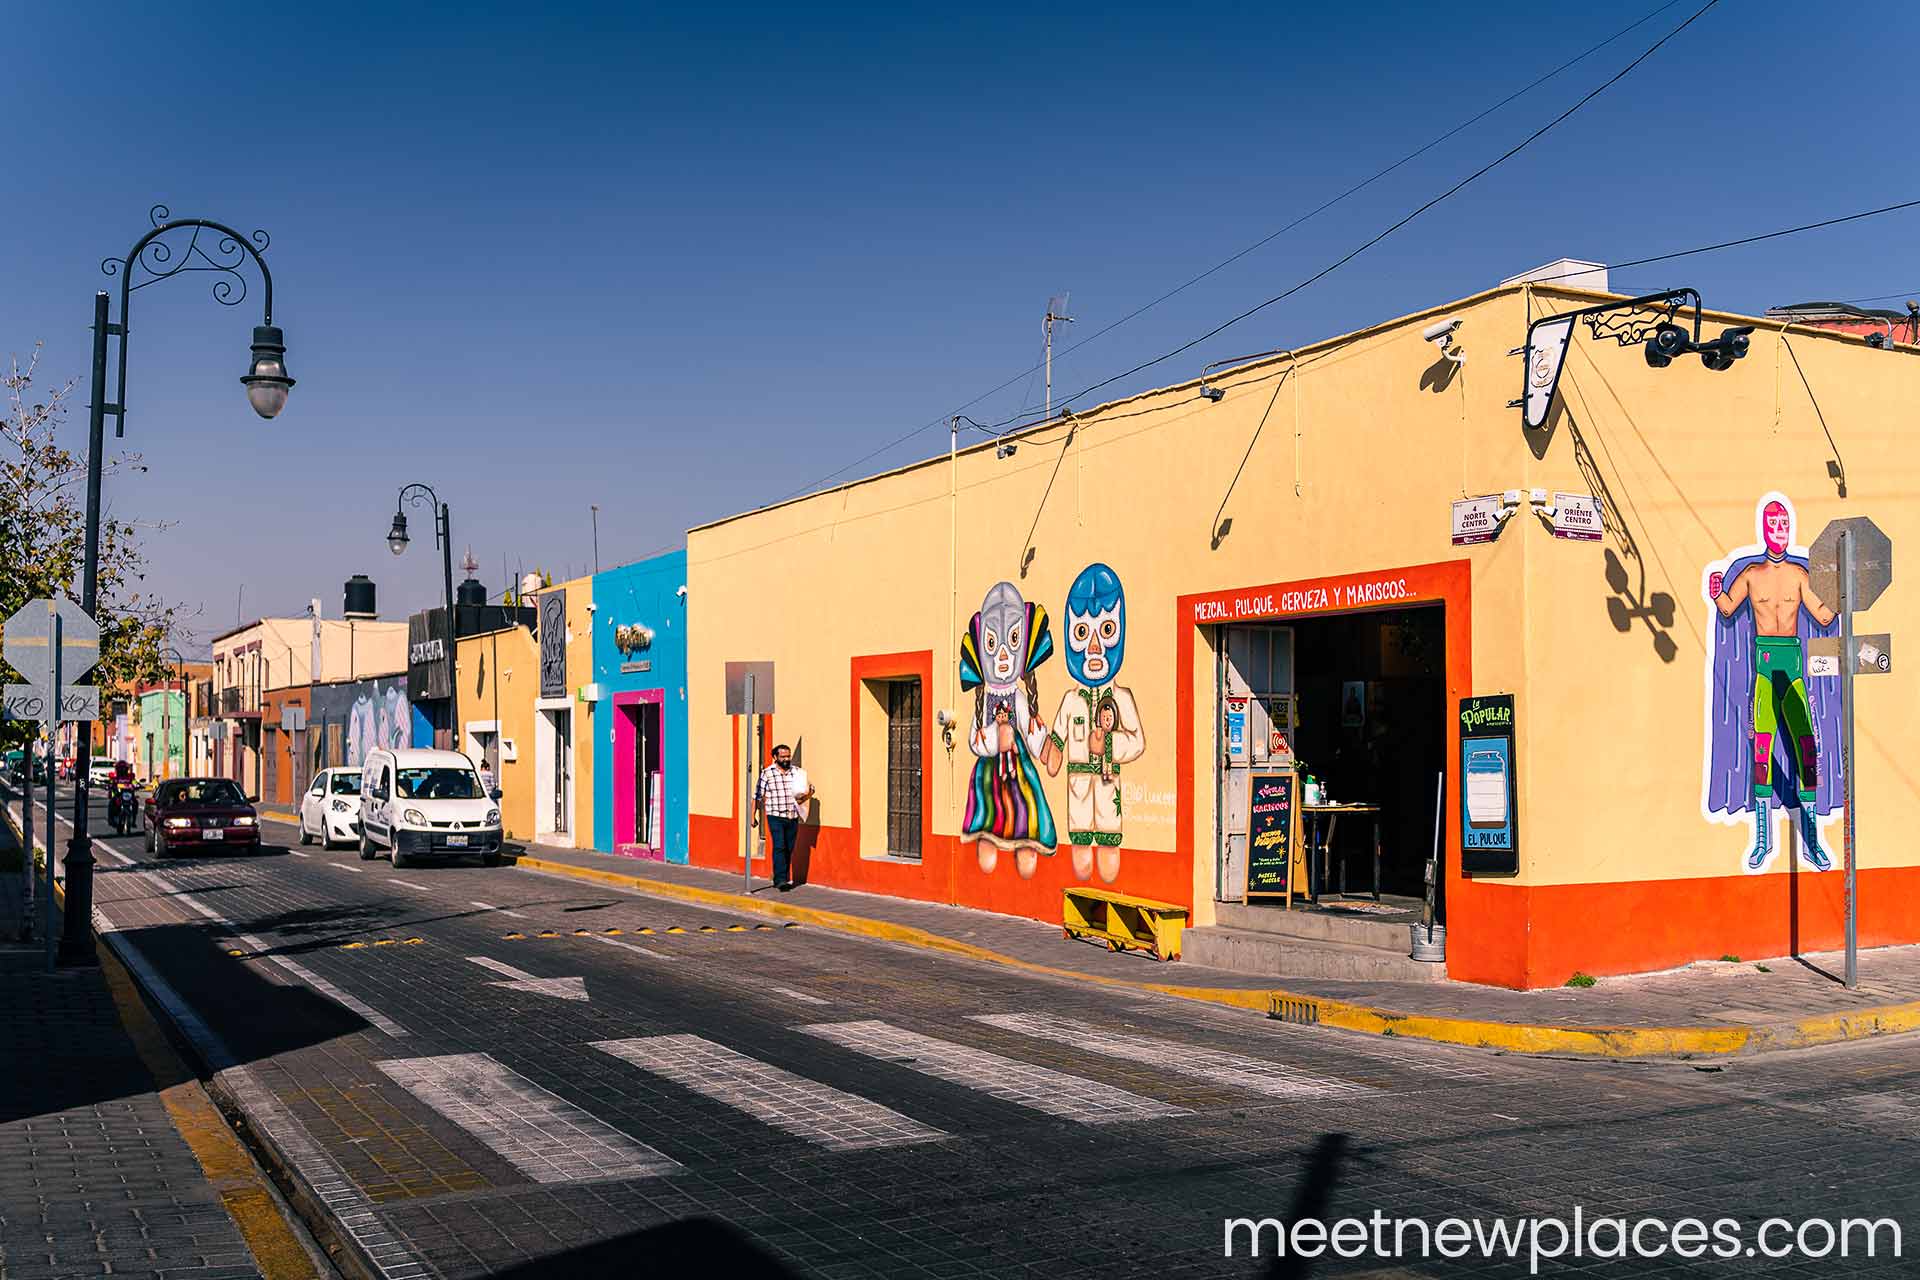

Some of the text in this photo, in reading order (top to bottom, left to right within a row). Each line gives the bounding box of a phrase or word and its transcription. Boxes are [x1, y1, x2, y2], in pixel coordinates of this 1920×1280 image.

[1464, 512, 1486, 521] NORTE
[1564, 508, 1593, 518] ORIENTE
[1462, 519, 1488, 529] CENTRO
[1564, 516, 1592, 525] CENTRO
[1235, 595, 1279, 617] PULQUE,
[1281, 588, 1329, 611] CERVEZA
[1333, 587, 1342, 607] Y
[1346, 578, 1417, 606] MARISCOS...
[1461, 706, 1511, 732] POPULAR
[1253, 800, 1289, 814] MARISCOS
[1468, 833, 1478, 846] EL
[1479, 832, 1507, 847] PULQUE
